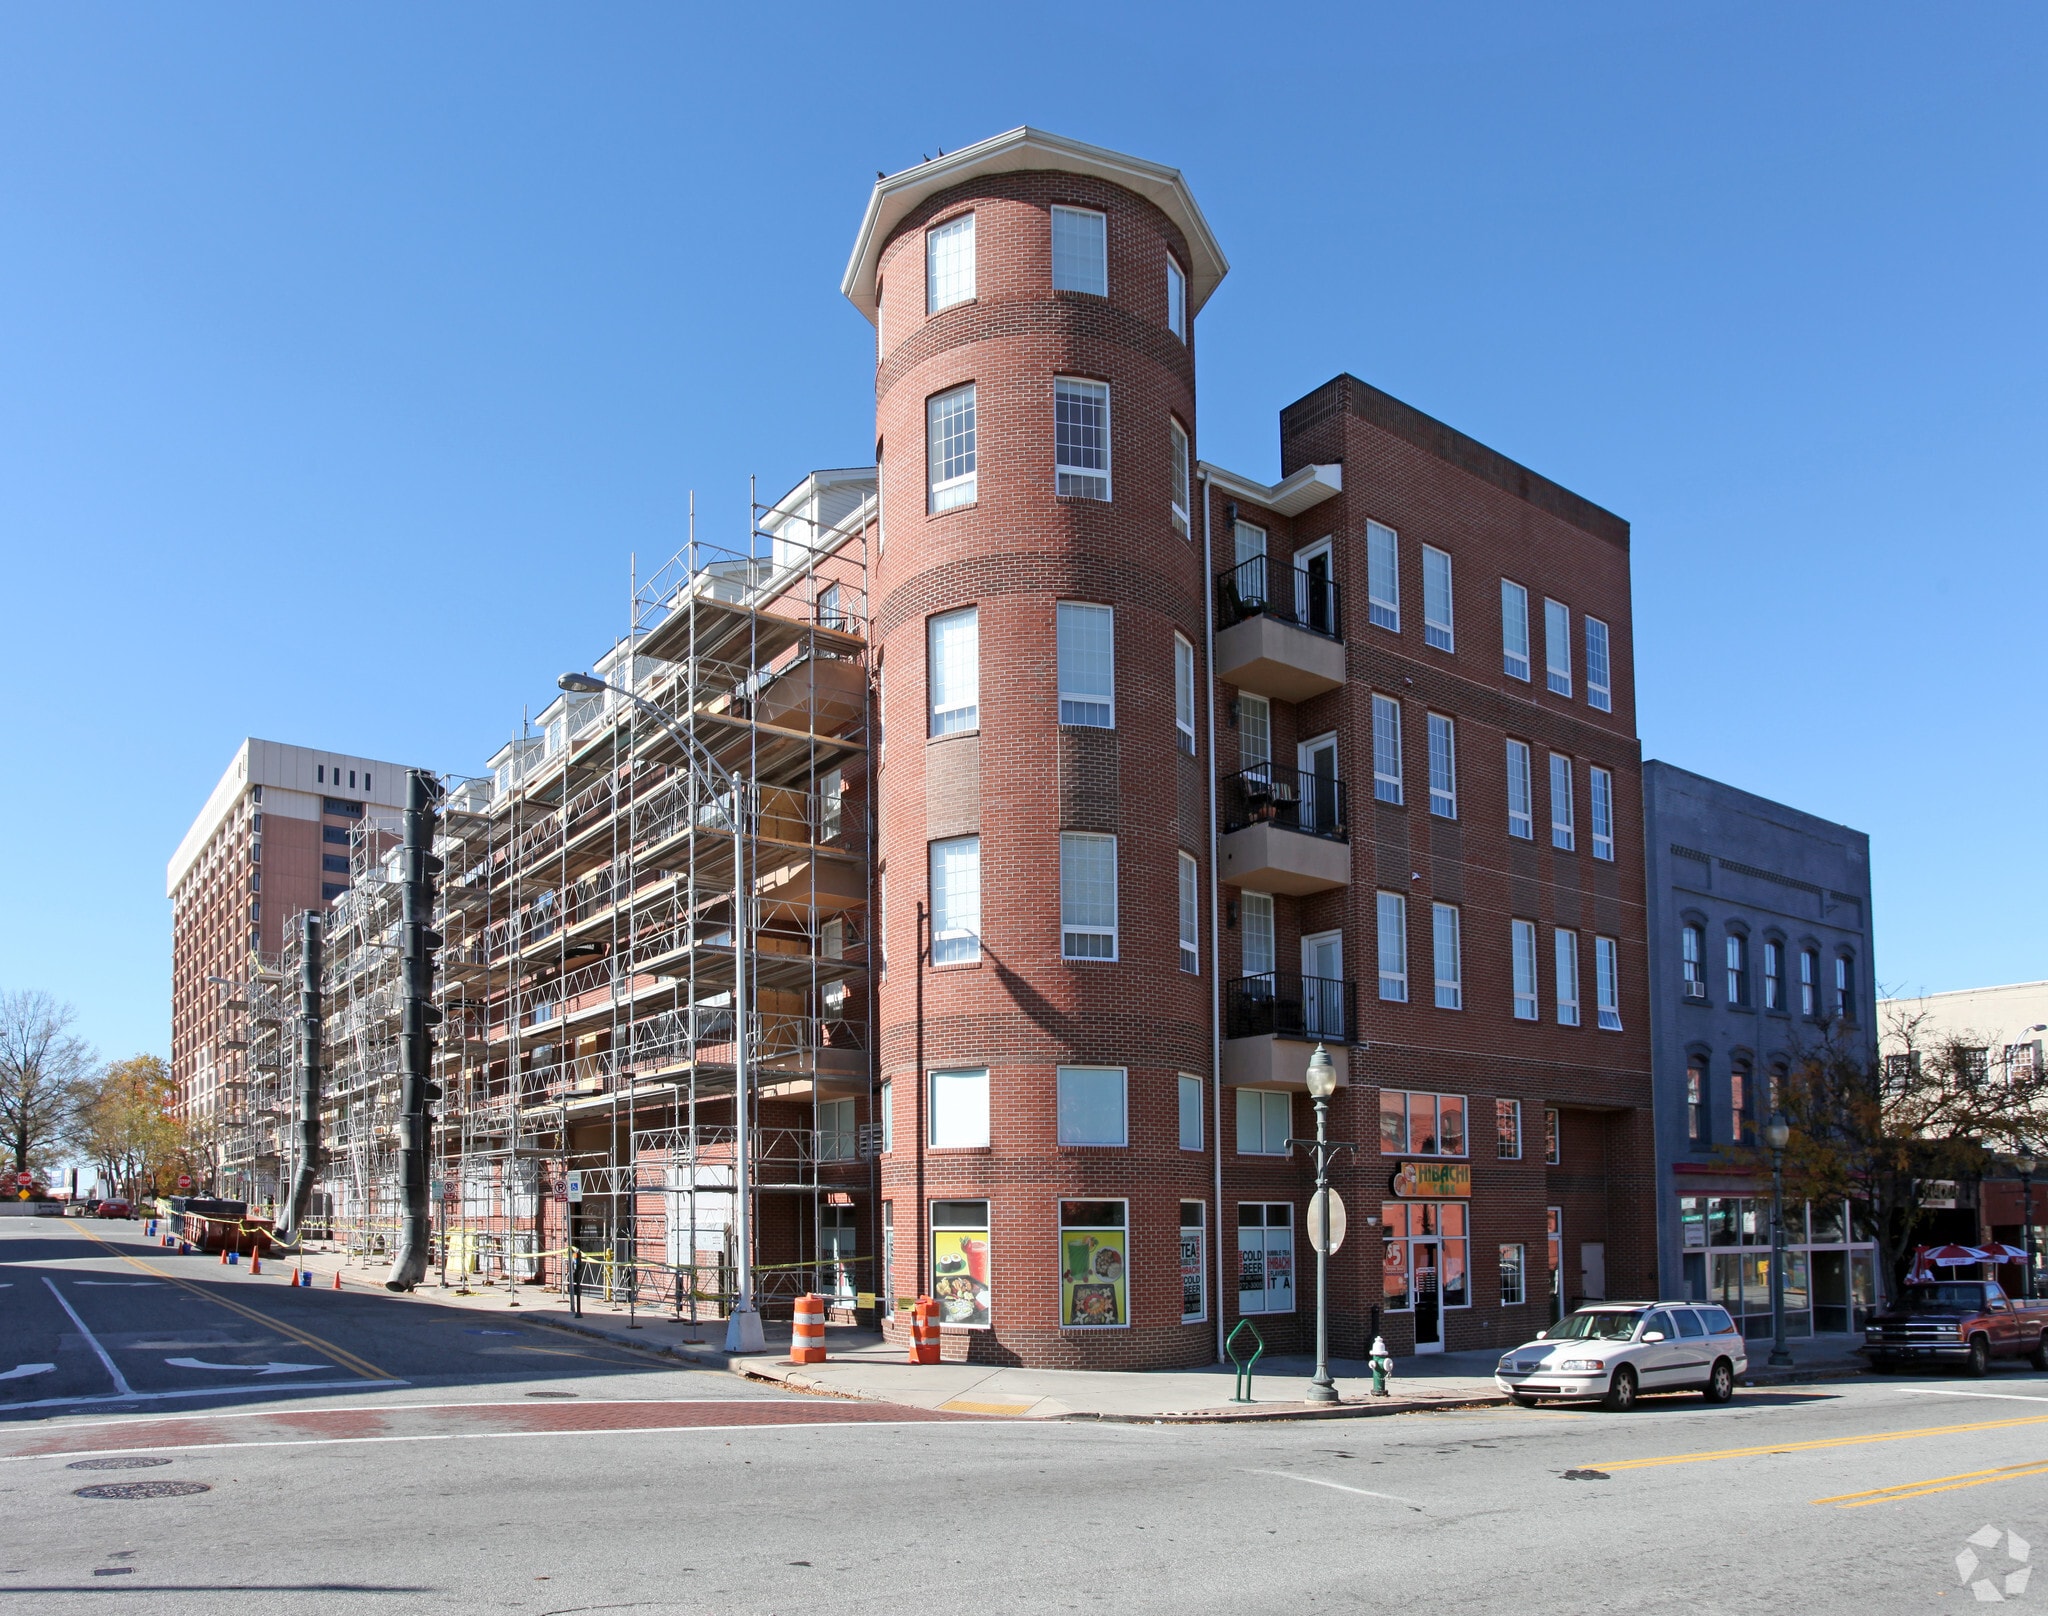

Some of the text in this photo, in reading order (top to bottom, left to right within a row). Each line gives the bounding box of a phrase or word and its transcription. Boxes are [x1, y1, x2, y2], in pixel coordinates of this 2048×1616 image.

[1419, 1165, 1468, 1184] HIBACHI
[1181, 1243, 1197, 1258] TEA
[1243, 1250, 1263, 1262] COLD
[1387, 1243, 1401, 1265] $5
[1243, 1262, 1263, 1274] BEER
[1184, 1276, 1200, 1285] COLD
[1184, 1285, 1200, 1294] BEER
